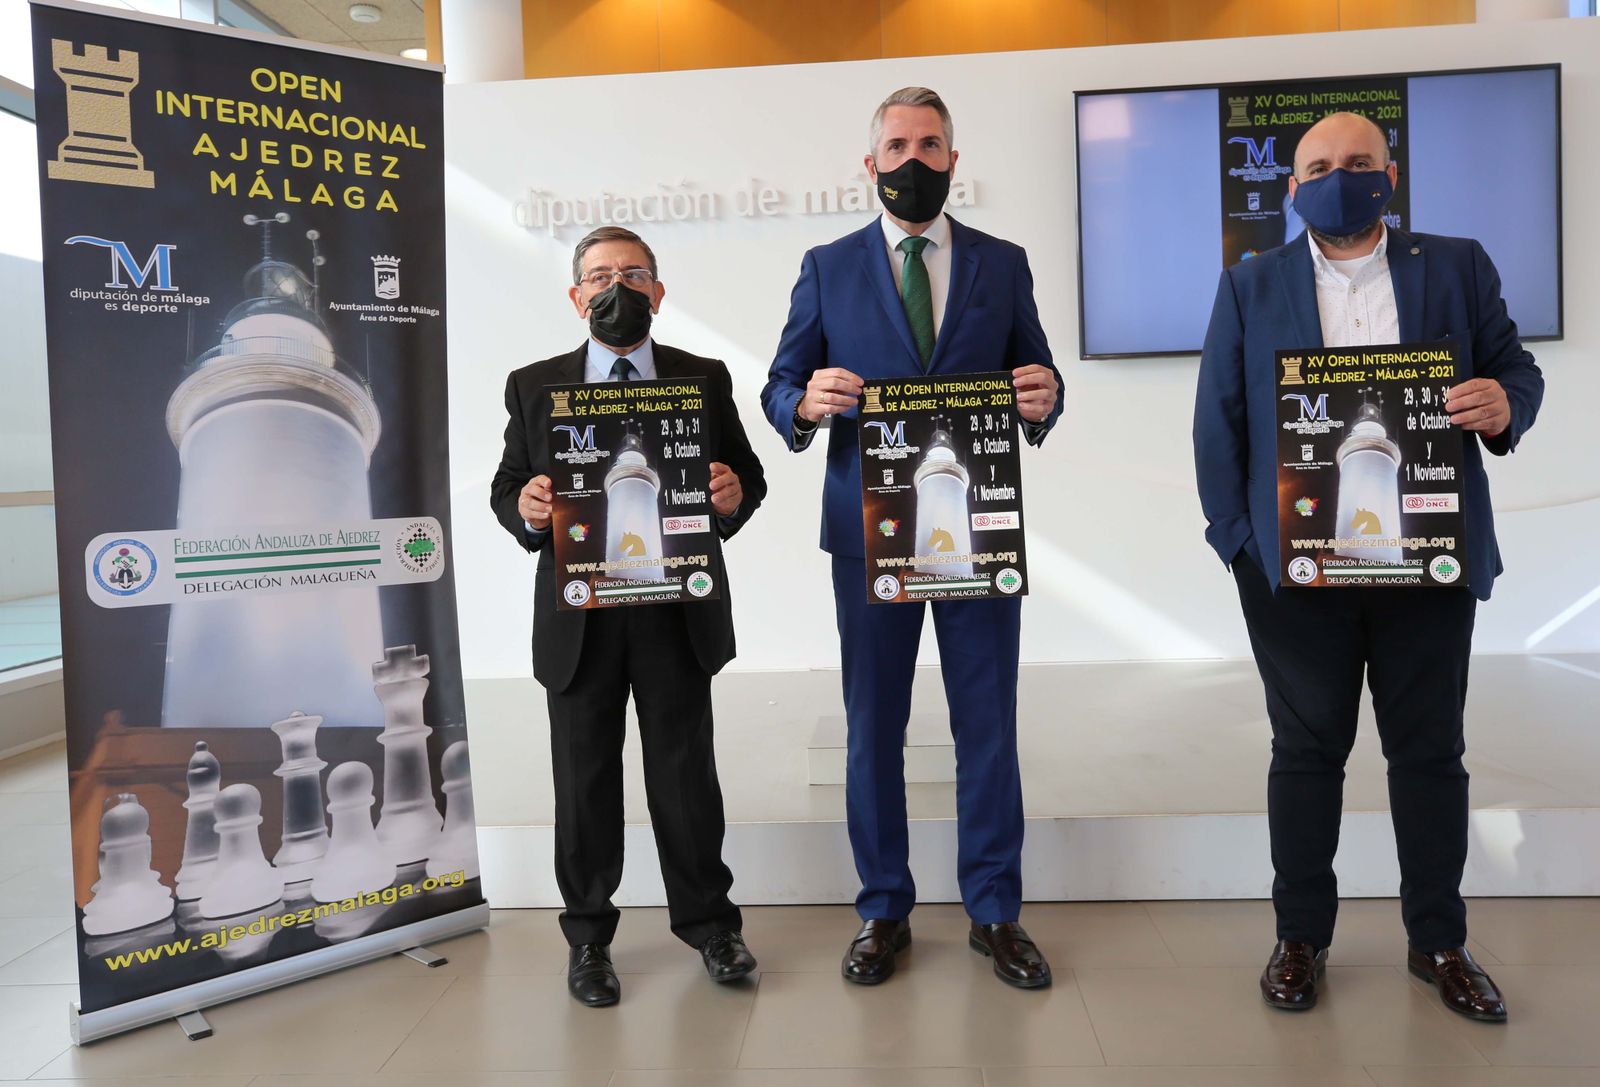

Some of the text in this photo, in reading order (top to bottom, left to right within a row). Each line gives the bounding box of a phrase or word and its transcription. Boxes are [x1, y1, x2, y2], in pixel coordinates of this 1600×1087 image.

[250, 67, 342, 103] OPEN
[1255, 90, 1400, 108] XV OPEN INTERNACIONAL
[155, 90, 426, 150] INTERNACIONAL
[1254, 115, 1267, 126] DE
[1270, 112, 1314, 125] AJEDREZ
[1378, 106, 1402, 118] 2021
[1389, 128, 1398, 147] 31
[193, 133, 400, 179] AJEDREZ
[211, 169, 399, 213] MÁLAGA
[512, 173, 976, 236] diputación de máa
[70, 288, 210, 306] diputación de málaga
[105, 302, 178, 314] es deporte
[329, 302, 440, 316] Ayuntamiento de Málaga
[360, 312, 377, 322] Área
[390, 316, 416, 324] Deporte
[1308, 351, 1452, 368] XV OPEN INTERNACIONAL
[1308, 374, 1320, 384] DE
[1322, 371, 1365, 384] AJEDREZ
[1376, 368, 1418, 380] MÁLAGA
[1429, 366, 1454, 378] 2021
[575, 385, 702, 400] XV OPEN INTERNACIONAL
[886, 380, 1010, 396] XV OPEN INTERNACIONAL
[1422, 386, 1430, 404] 30
[1434, 394, 1438, 406] y
[576, 406, 587, 416] DE
[590, 404, 628, 415] AJEDREZ
[636, 400, 672, 412] MÁLAGA
[682, 399, 702, 410] 2021
[886, 402, 898, 412] DE
[900, 400, 937, 411] AJEDREZ
[946, 395, 982, 408] MÁLAGA
[991, 394, 1012, 406] 2021
[676, 418, 684, 435] 30
[686, 426, 690, 436] y
[692, 418, 700, 434] 31
[985, 414, 993, 430] 30
[996, 420, 999, 432] y
[1002, 413, 1010, 430] 31
[1407, 412, 1450, 430] de Octubre
[664, 442, 700, 458] de Octubre
[973, 437, 1010, 454] de Octubre
[1427, 442, 1432, 459] y
[681, 469, 686, 484] y
[990, 465, 995, 481] y
[1406, 464, 1455, 482] 1 Noviembre
[664, 488, 706, 506] 1 Noviembre
[974, 484, 1016, 501] 1 Noviembre
[174, 529, 380, 555] FEDERACIÓN ANDALUZA DE AJEDREZ
[1291, 536, 1456, 550] www.ajedrezmalaga.org
[566, 554, 708, 574] www.ajedrezmalaga.org
[876, 551, 1018, 569] www.ajedrezmalaga.org
[184, 568, 376, 594] DELEGACIÓN MALAGUEÑA
[1326, 575, 1421, 584] DELEGACIÓN MALAGUEÑA
[598, 592, 680, 604] DELEGACIÓN MALAGUEÑA
[908, 587, 988, 599] DELEGACIÓN MALAGUEÑA
[105, 869, 465, 971] www.ajedrezmalaga.org
